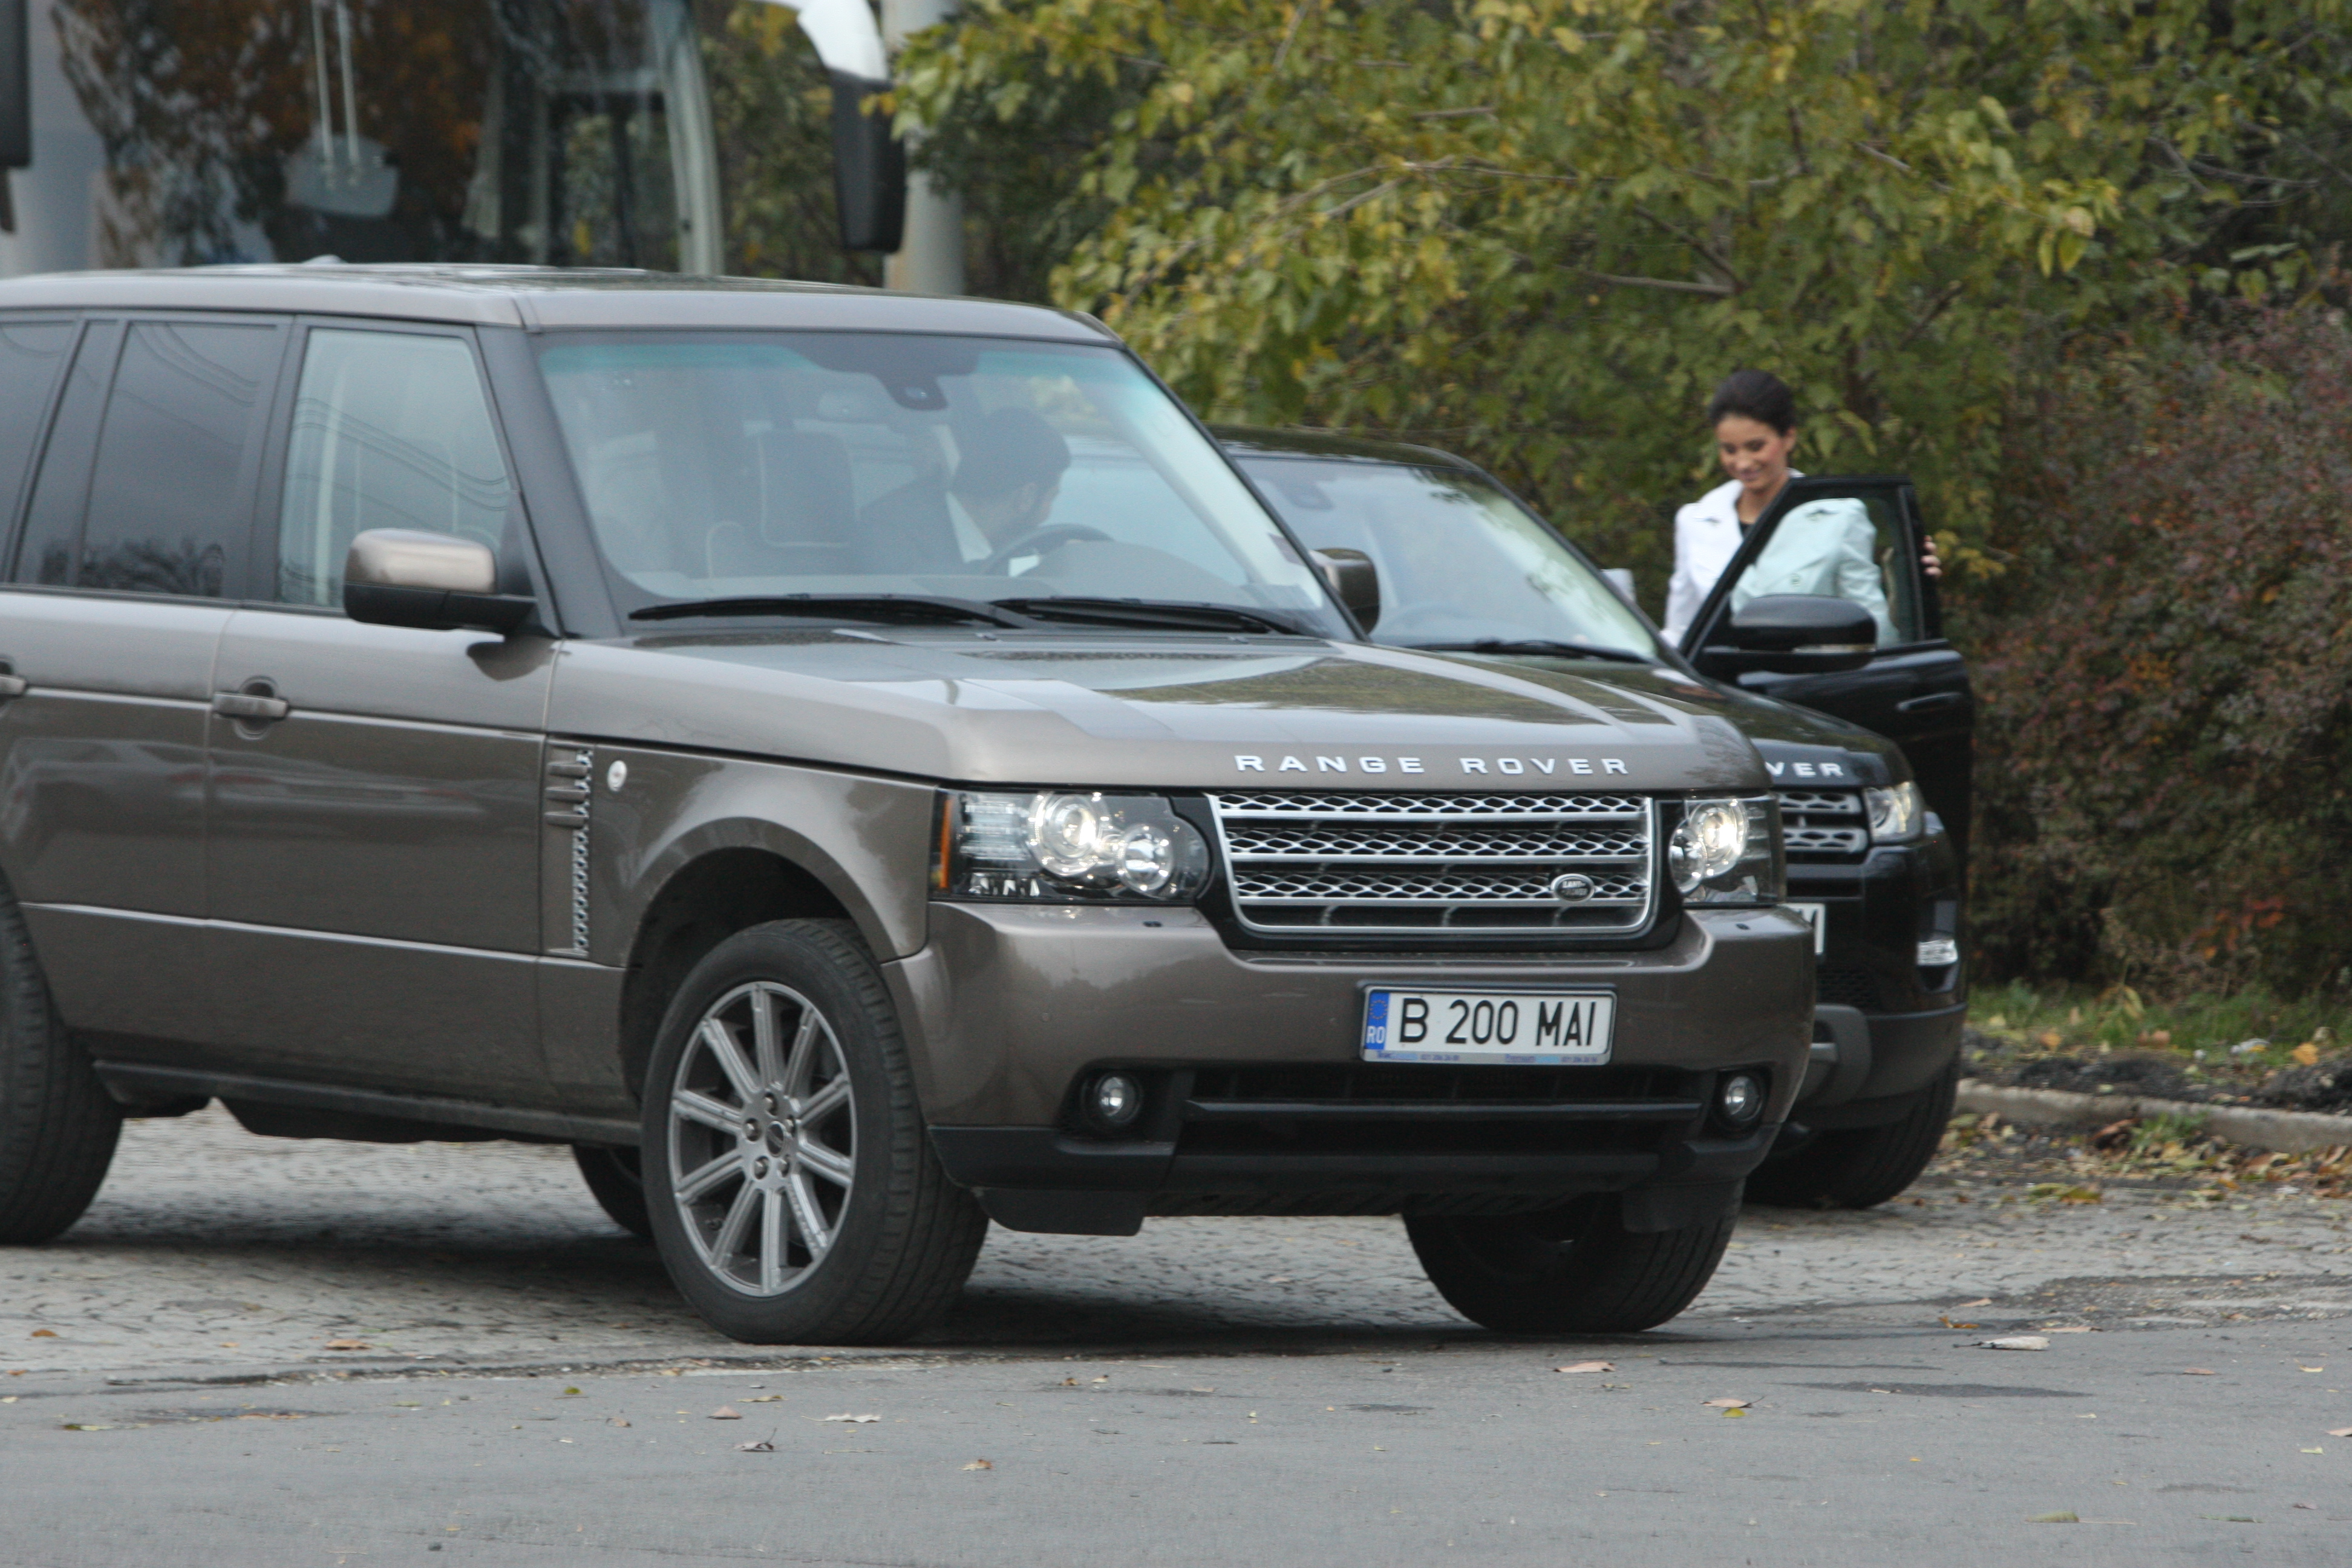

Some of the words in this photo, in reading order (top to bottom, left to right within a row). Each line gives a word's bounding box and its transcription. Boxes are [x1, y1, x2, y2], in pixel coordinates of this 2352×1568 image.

[1234, 755, 1425, 773] RANGE
[1459, 757, 1629, 774] ROVER
[1399, 998, 1430, 1043] B
[1445, 999, 1519, 1045] 200
[1535, 1001, 1597, 1047] MAI
[1366, 1025, 1385, 1044] RO
